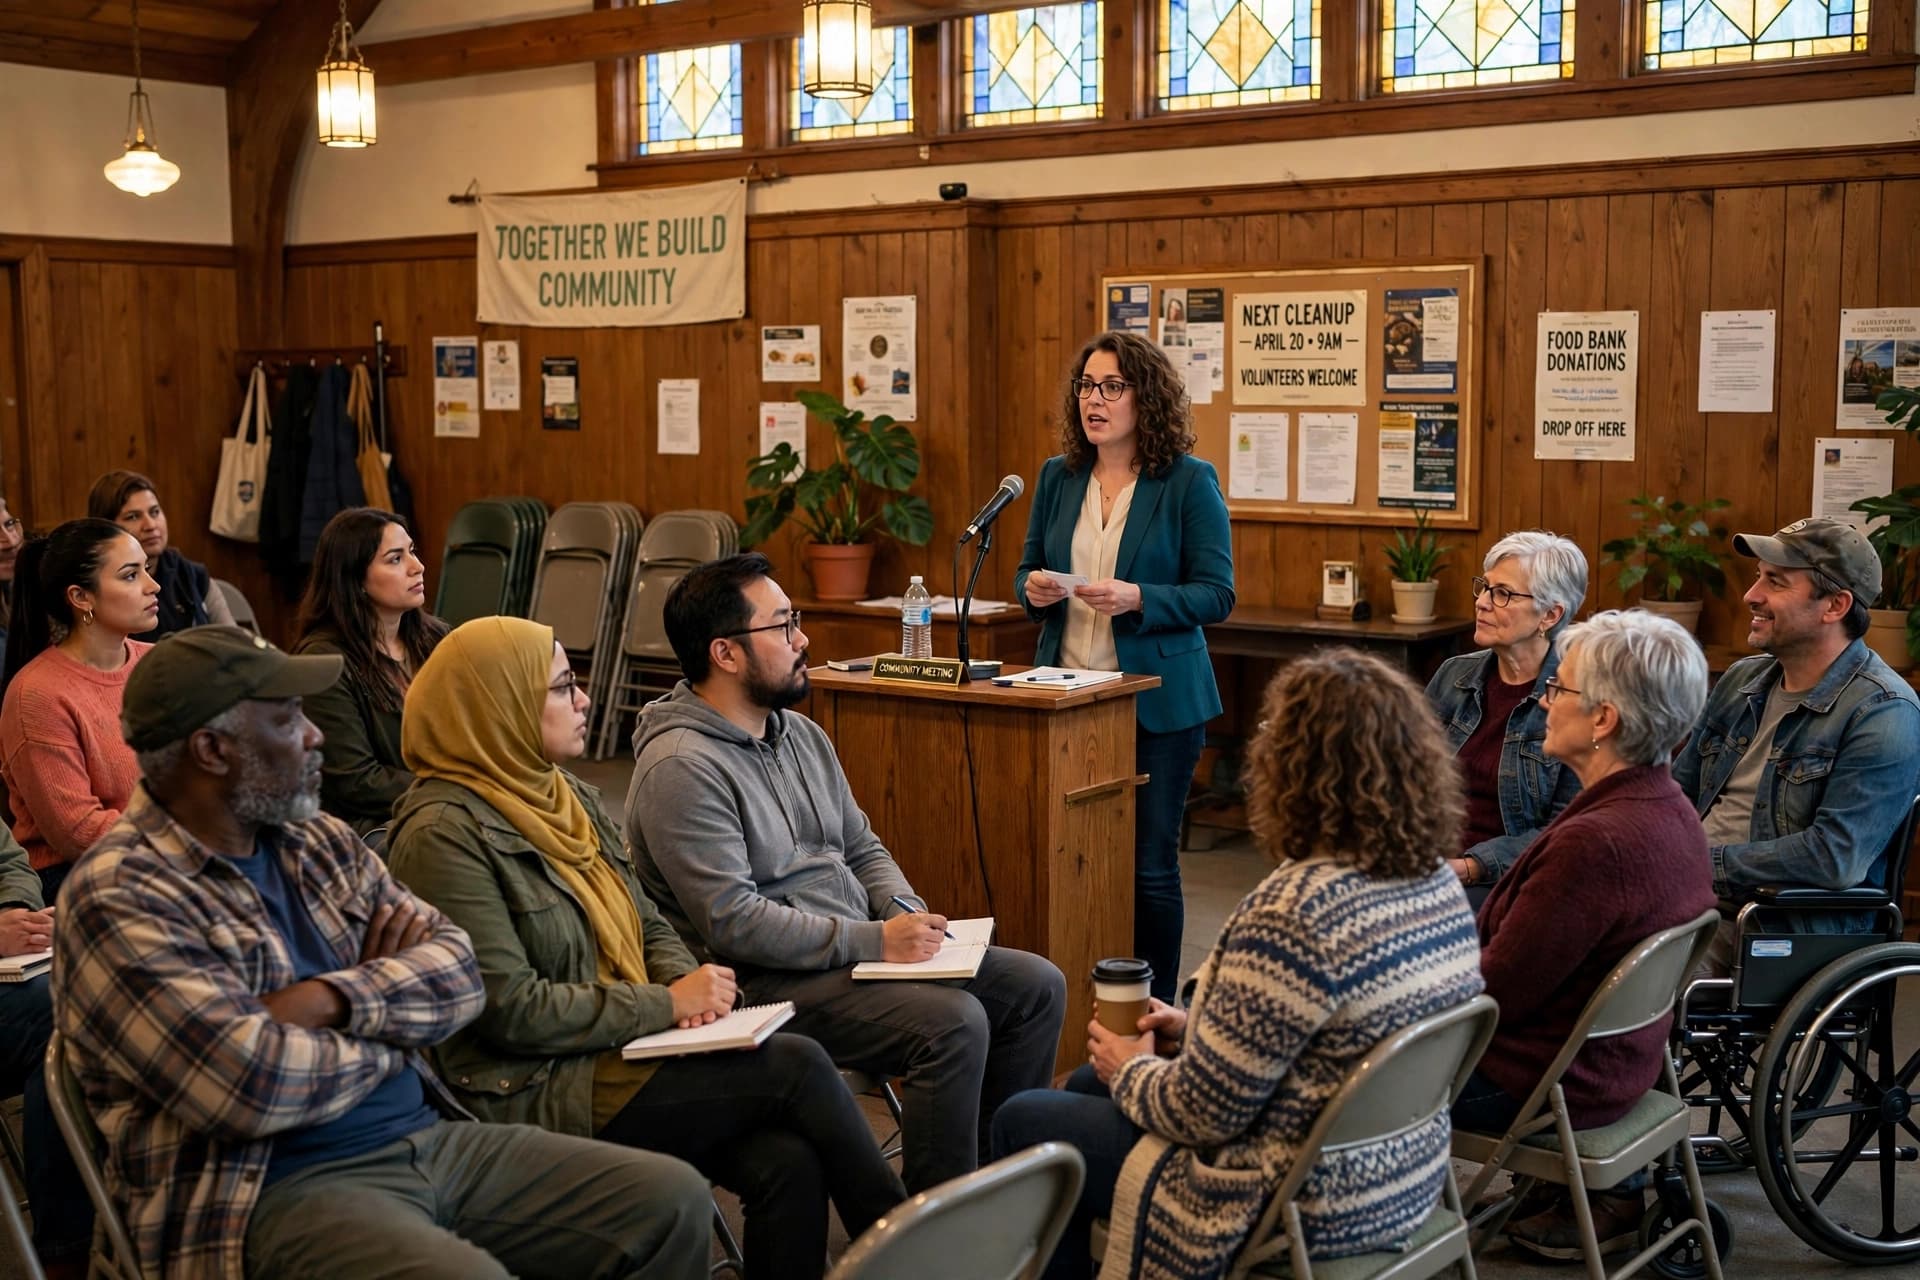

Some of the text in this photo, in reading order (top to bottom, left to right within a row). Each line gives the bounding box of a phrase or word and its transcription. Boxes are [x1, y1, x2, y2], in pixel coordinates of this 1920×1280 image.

[495, 215, 726, 261] TOGETHER WE BUILD
[538, 267, 676, 308] COMMUNITY
[1242, 304, 1280, 326] NEXT
[1285, 302, 1355, 326] CLEANUP
[1254, 332, 1342, 350] APRIL 20 9AM
[1547, 330, 1627, 350] FOOD BANK
[1547, 352, 1626, 371] DONATIONS
[1241, 368, 1358, 387] VOLUNTEERS WELCOME
[1542, 420, 1627, 437] DROP OFF HERE
[879, 663, 953, 678] COMMUNITY MEETING
